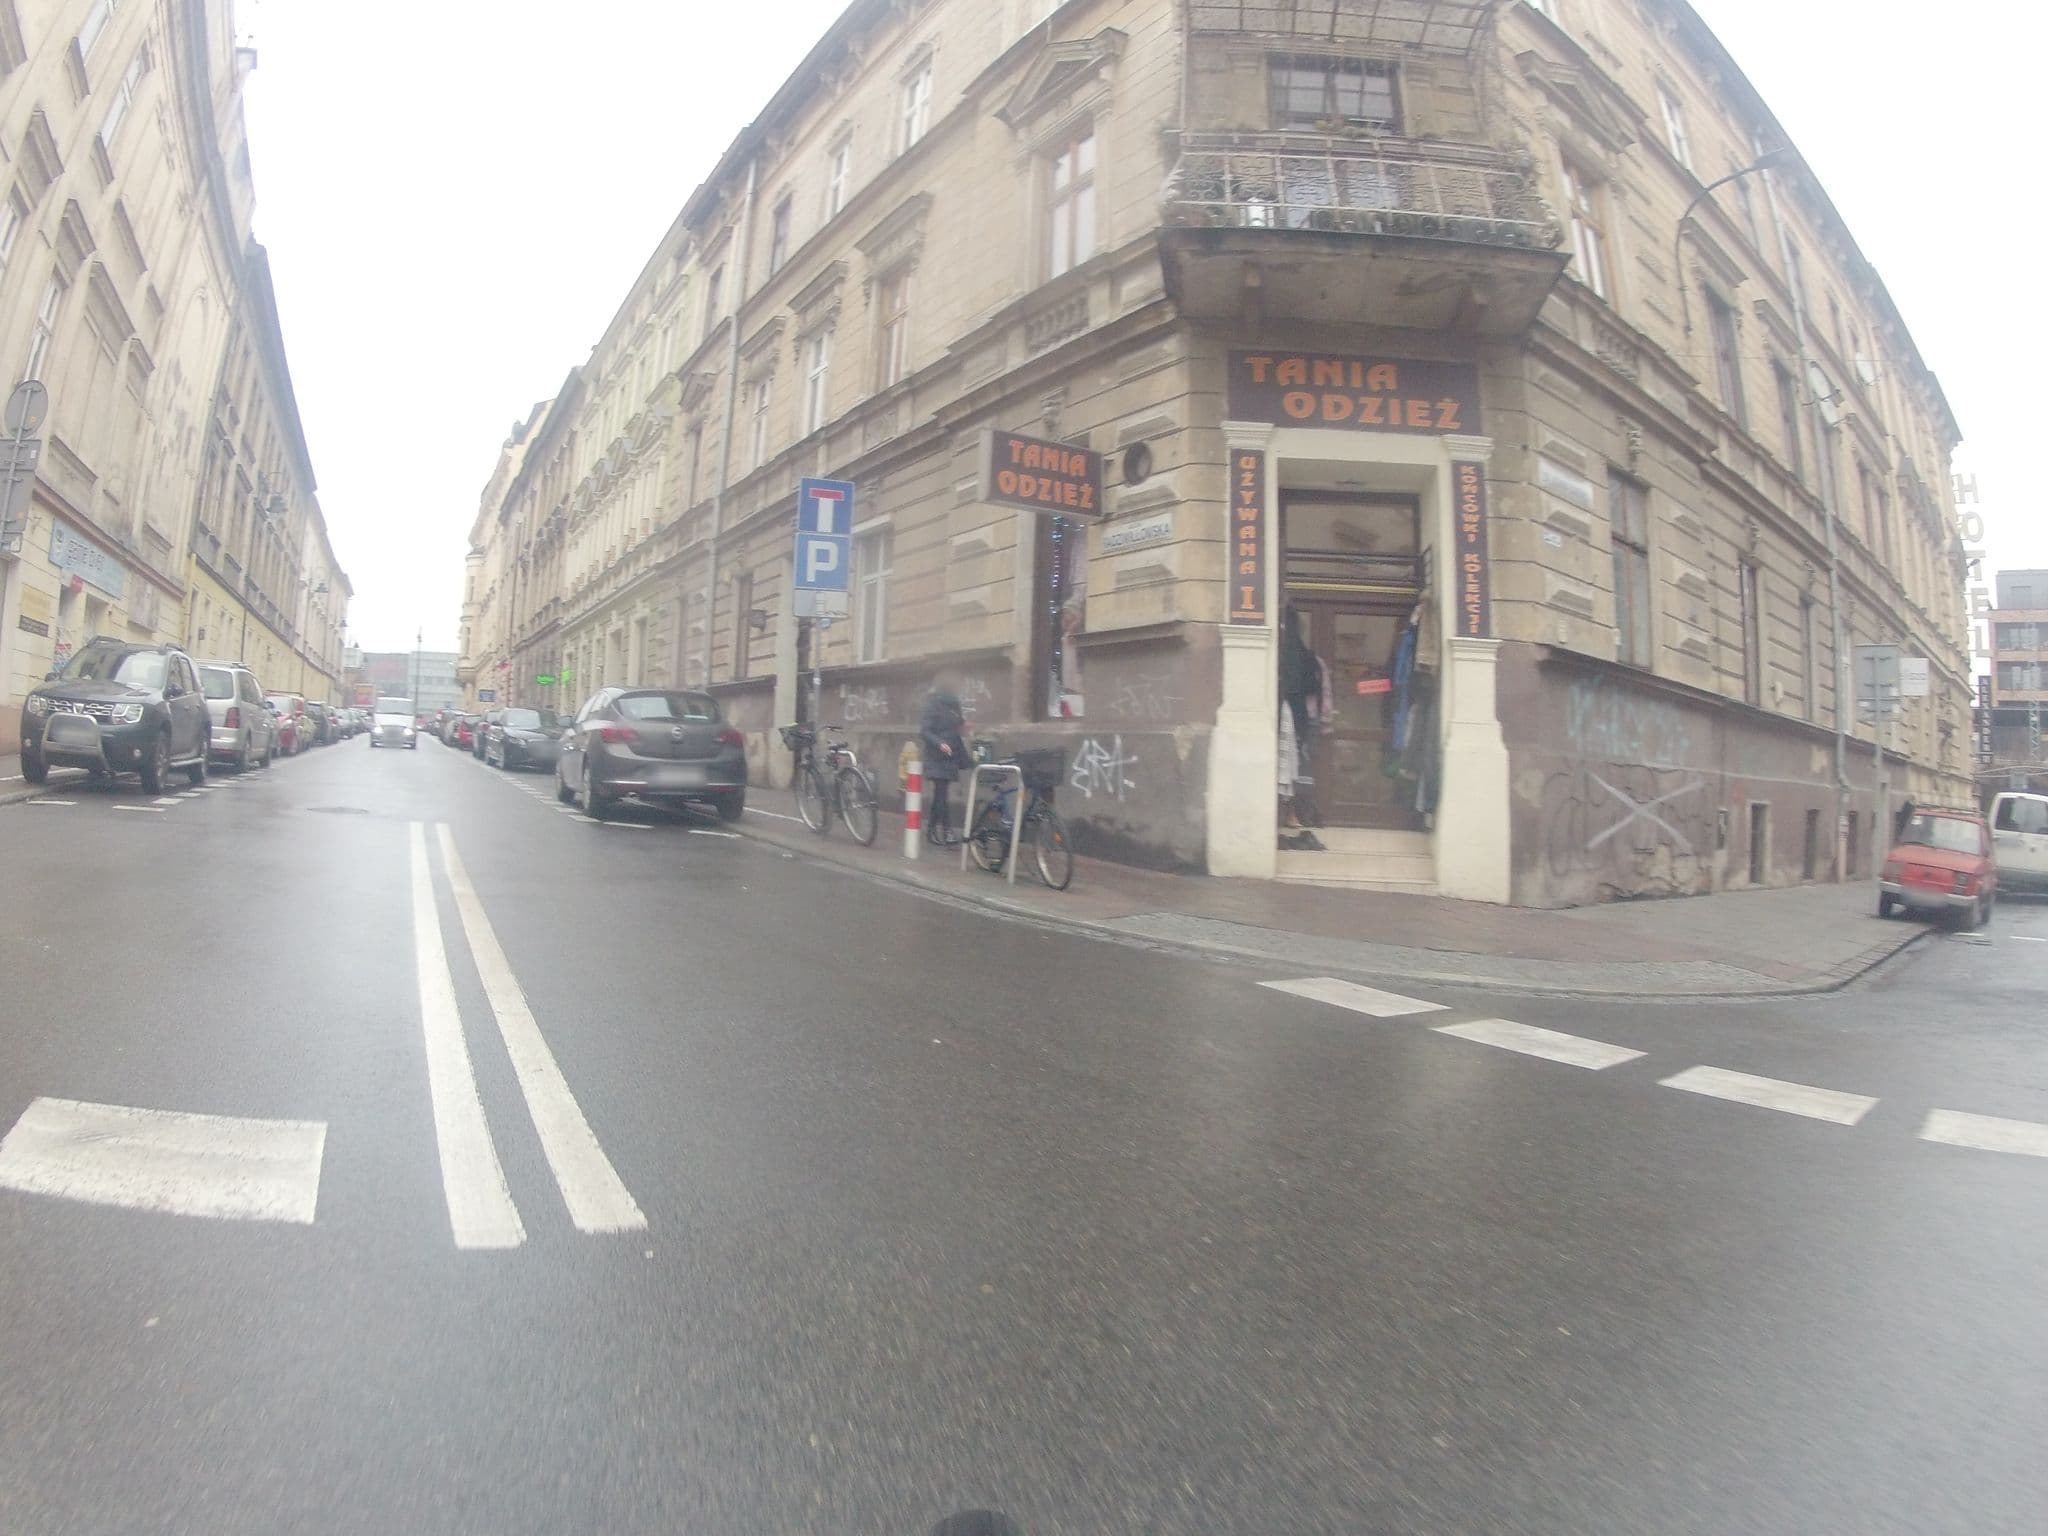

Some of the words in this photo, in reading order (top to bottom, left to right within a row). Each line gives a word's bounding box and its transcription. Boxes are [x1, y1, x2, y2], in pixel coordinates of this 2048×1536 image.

[1244, 356, 1398, 391] TANIA
[1283, 391, 1462, 430] ODZIEŻ
[1008, 439, 1086, 478] TANIA
[997, 470, 1094, 509] ODZIEŻ
[1237, 456, 1259, 575] UŻYWANA
[806, 540, 839, 582] P
[1957, 472, 1993, 658] HOTEL
[1464, 553, 1482, 634] KOLEKCJI
